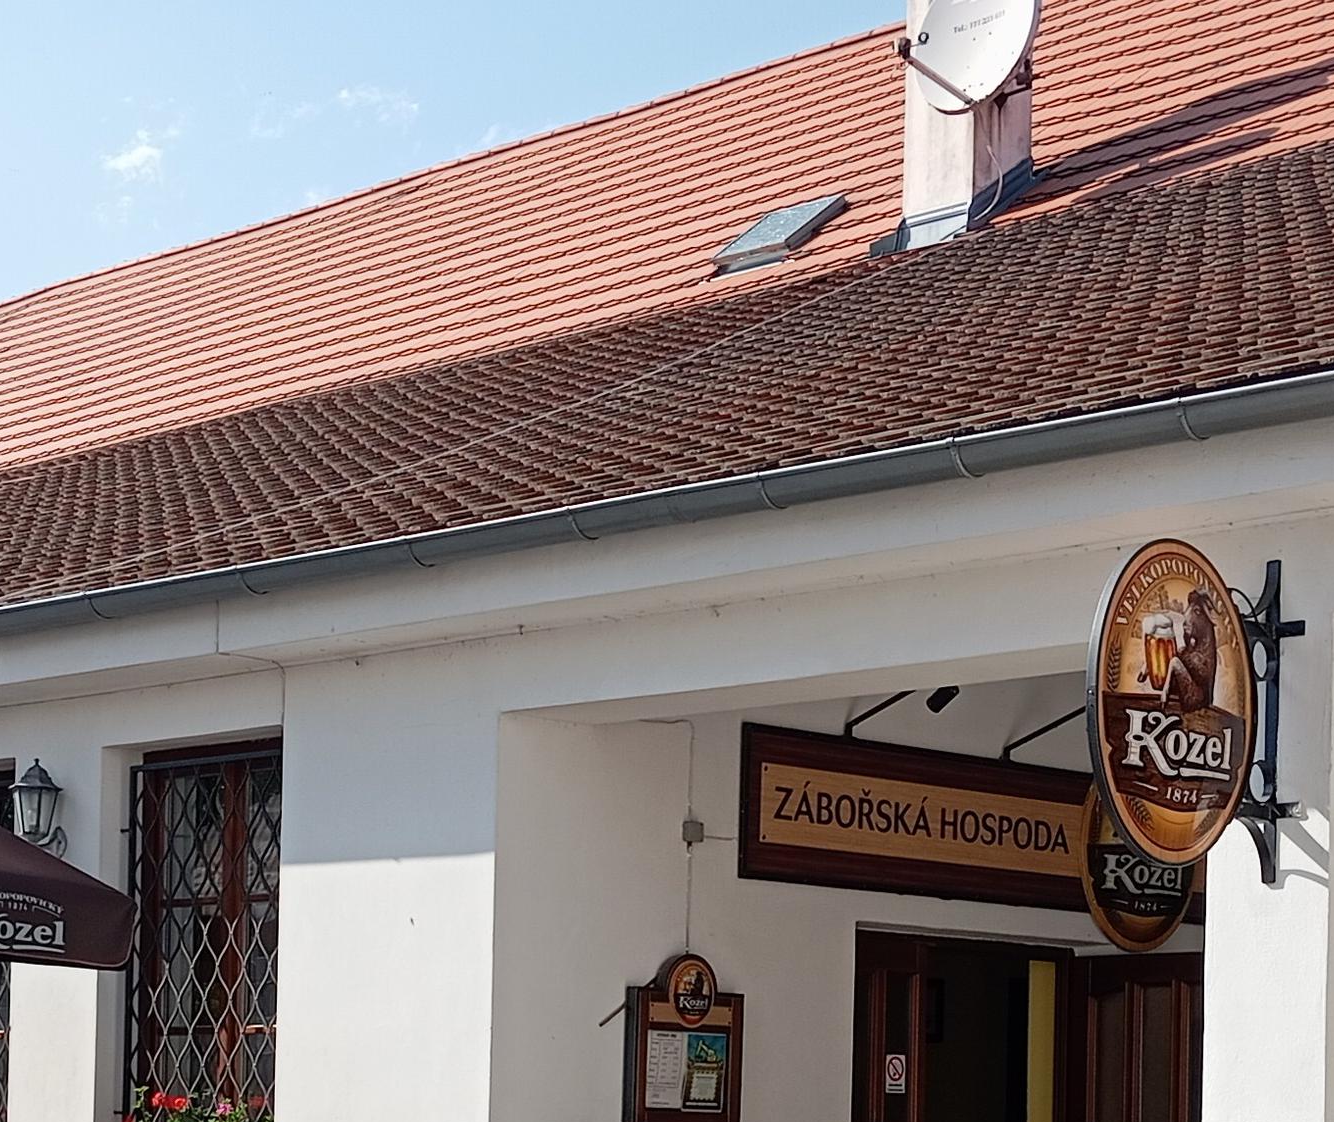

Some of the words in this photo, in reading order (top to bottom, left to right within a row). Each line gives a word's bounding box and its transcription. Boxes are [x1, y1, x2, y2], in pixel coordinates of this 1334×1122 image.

[1122, 708, 1232, 777] Kozel
[773, 780, 932, 838] ZÁBOŘSKÁ
[940, 807, 1070, 854] HOSPODA
[1166, 786, 1198, 804] 1874
[1101, 853, 1183, 895] Kozel
